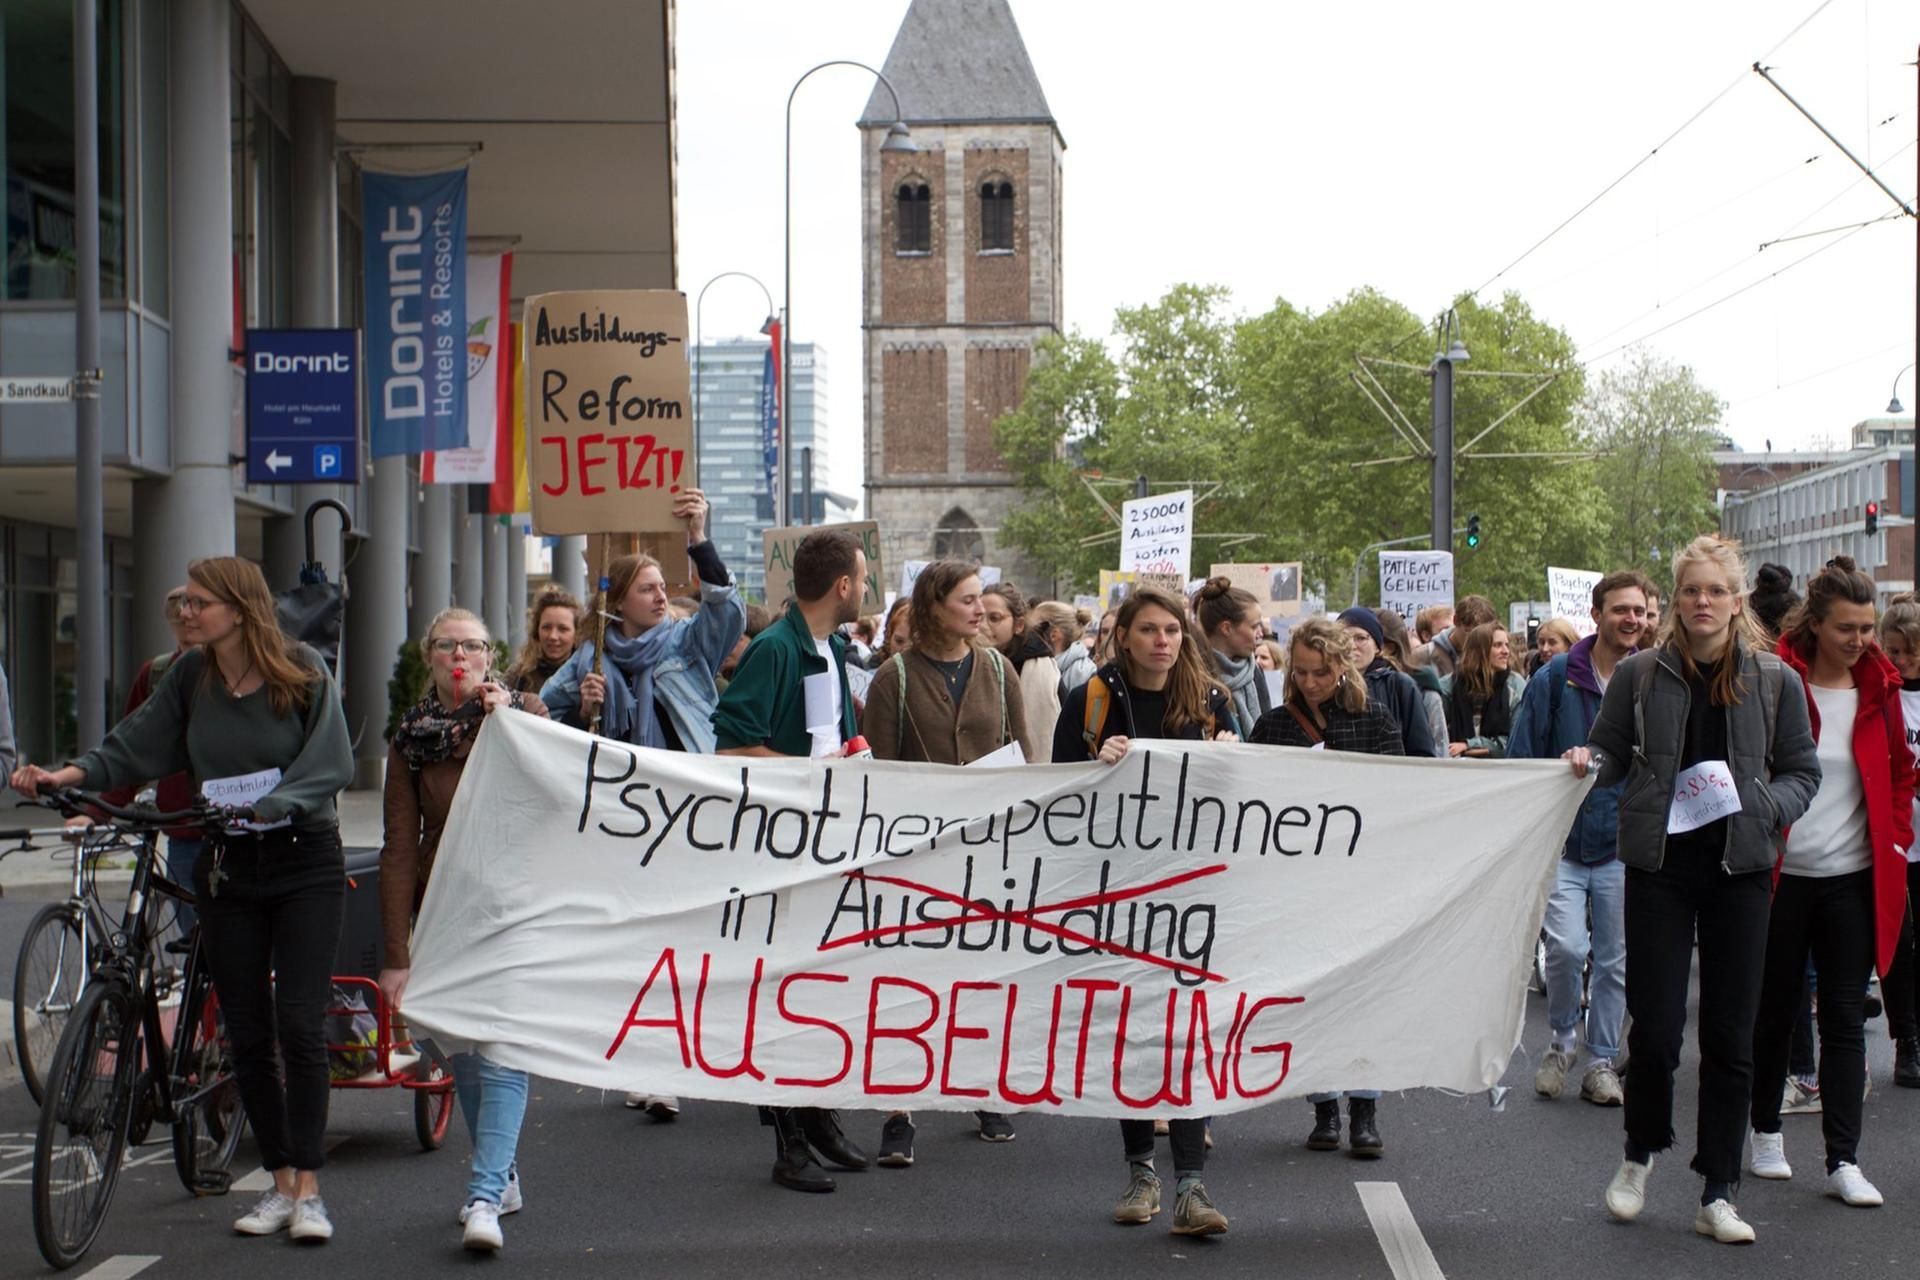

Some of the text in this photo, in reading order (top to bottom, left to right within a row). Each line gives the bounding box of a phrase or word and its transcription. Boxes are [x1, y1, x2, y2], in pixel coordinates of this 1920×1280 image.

[381, 205, 426, 420] Dorint
[430, 202, 454, 417] Hotels & Resorts
[535, 307, 681, 358] Ausbildungs-
[254, 352, 350, 373] Dorint
[541, 369, 683, 426] Reform
[321, 454, 336, 473] P
[540, 433, 685, 497] JETZT!
[1383, 559, 1440, 575] PATIENT
[1384, 576, 1449, 593] GEHEILT
[578, 740, 1363, 870] PsychotherapeutInnen
[720, 855, 1217, 986] in Ausbildung
[605, 946, 1306, 1109] AUSBEUTUNG
